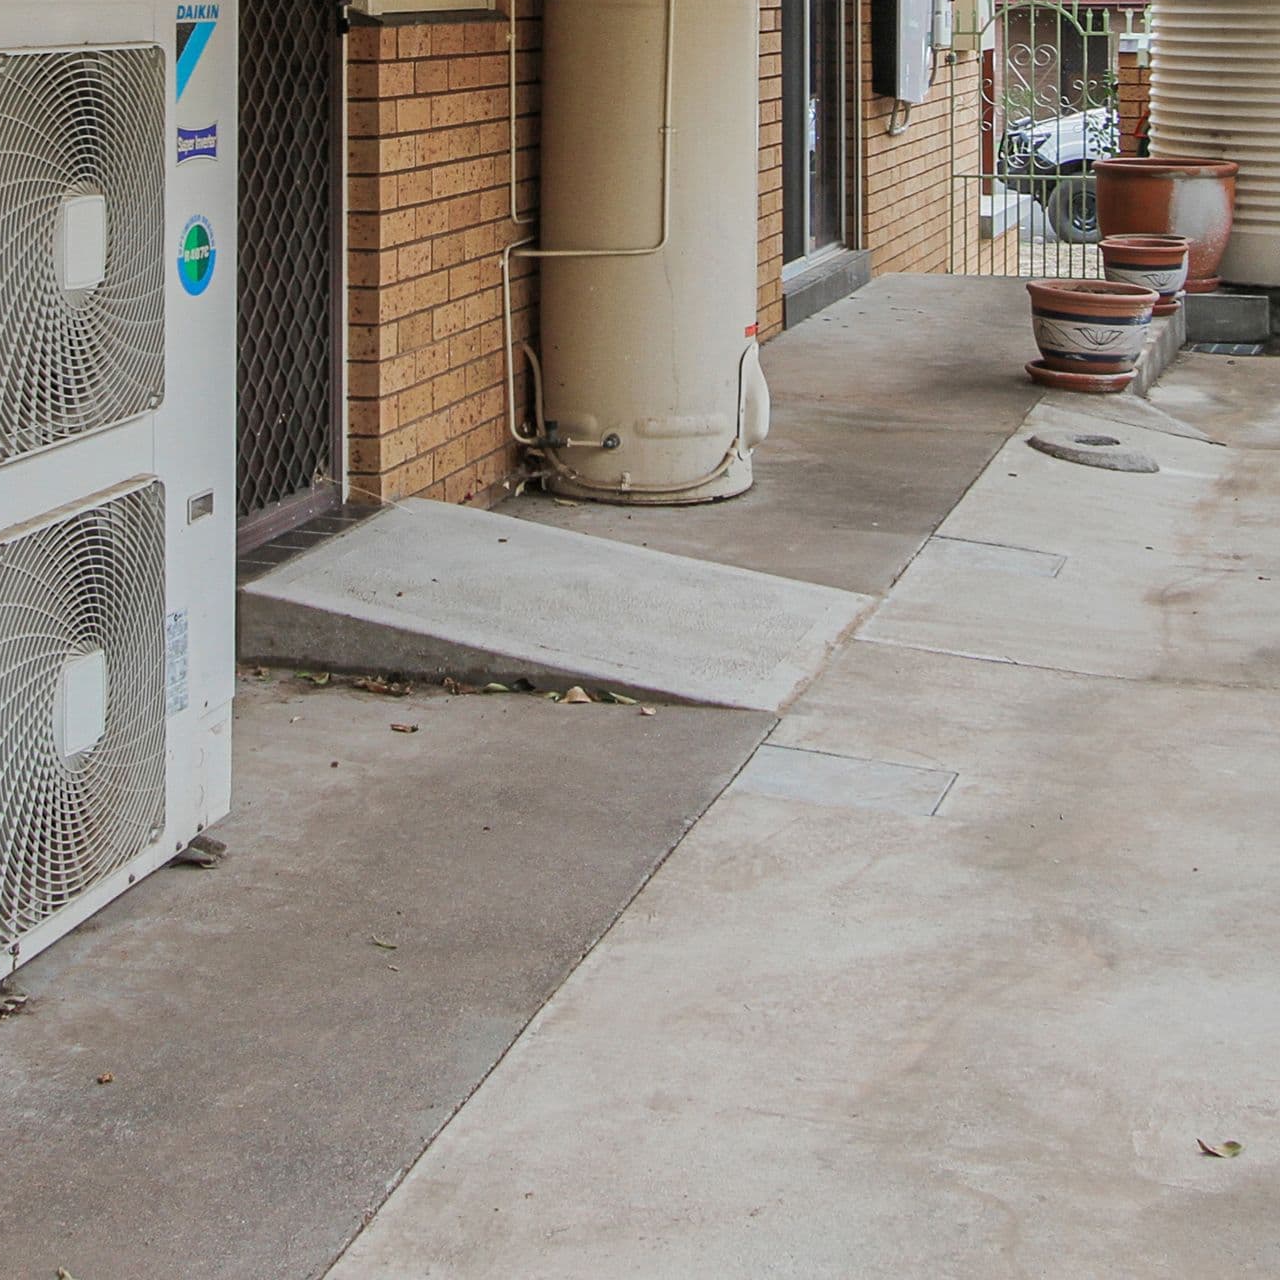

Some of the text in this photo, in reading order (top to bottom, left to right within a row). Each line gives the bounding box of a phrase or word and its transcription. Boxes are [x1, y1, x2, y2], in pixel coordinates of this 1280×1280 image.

[176, 4, 219, 20] DAIKIN
[178, 134, 217, 155] Super Inverter
[184, 245, 210, 263] R407C
